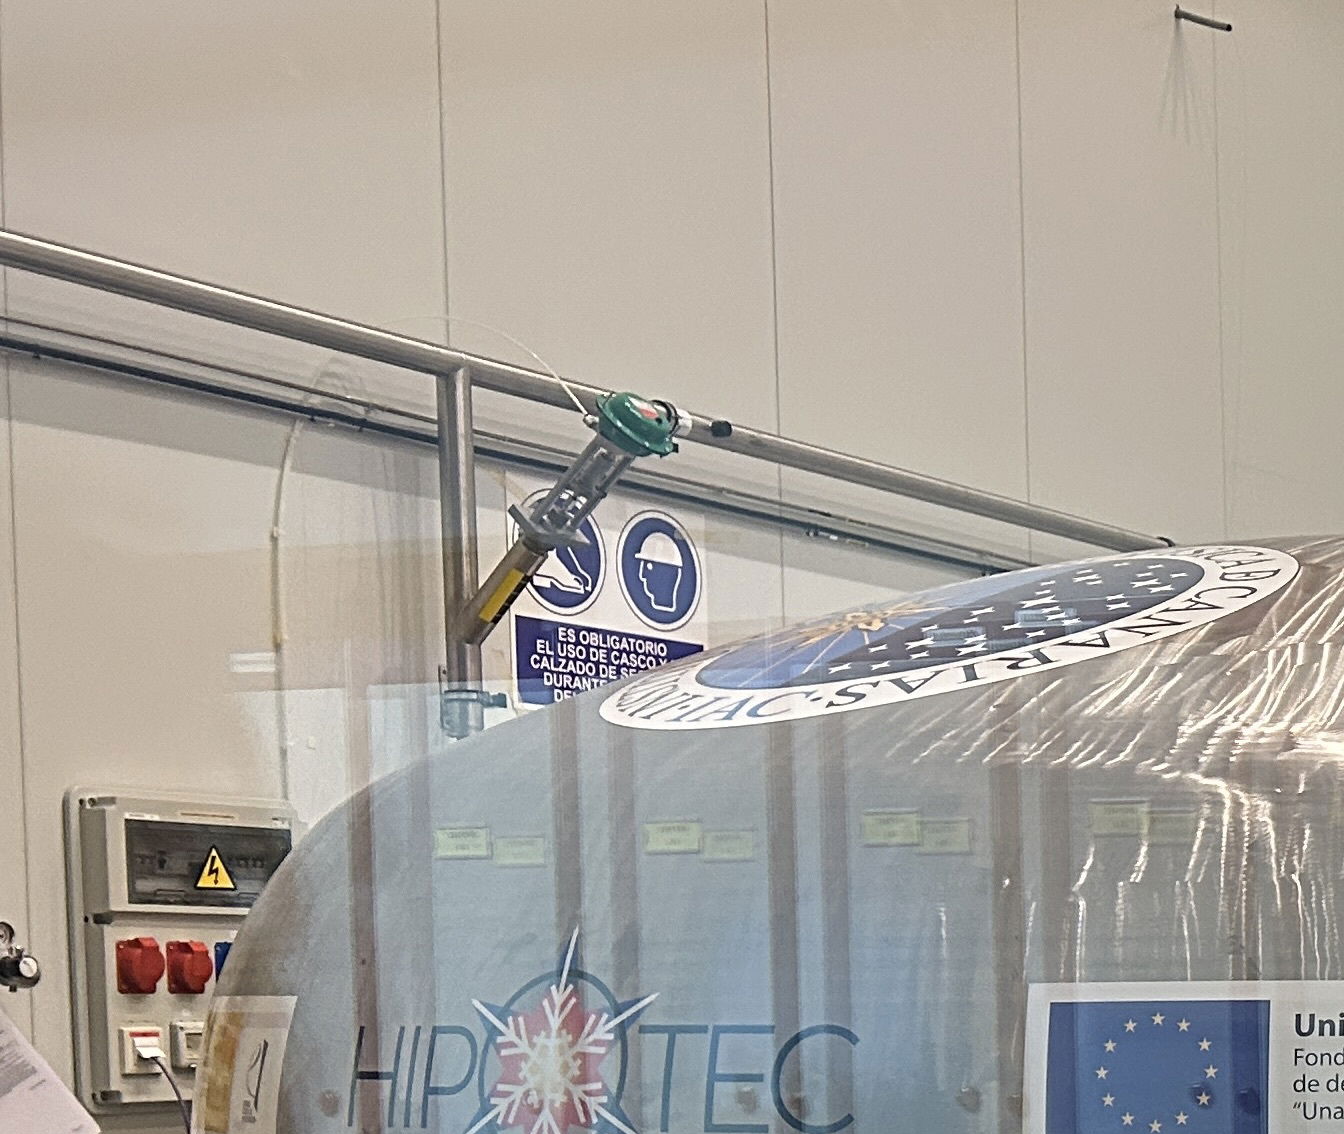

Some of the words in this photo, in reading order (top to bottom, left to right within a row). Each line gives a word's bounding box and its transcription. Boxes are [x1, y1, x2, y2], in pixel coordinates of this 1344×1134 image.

[536, 639, 554, 656] EL
[557, 642, 586, 660] USO
[589, 648, 608, 664] DE
[611, 651, 657, 670] CASCO
[558, 626, 576, 643] ES
[579, 630, 668, 657] OBLIGATORIO
[530, 654, 596, 676] CALZADO
[599, 664, 617, 680] DE
[553, 688, 577, 703] DE
[1292, 1072, 1321, 1093] de
